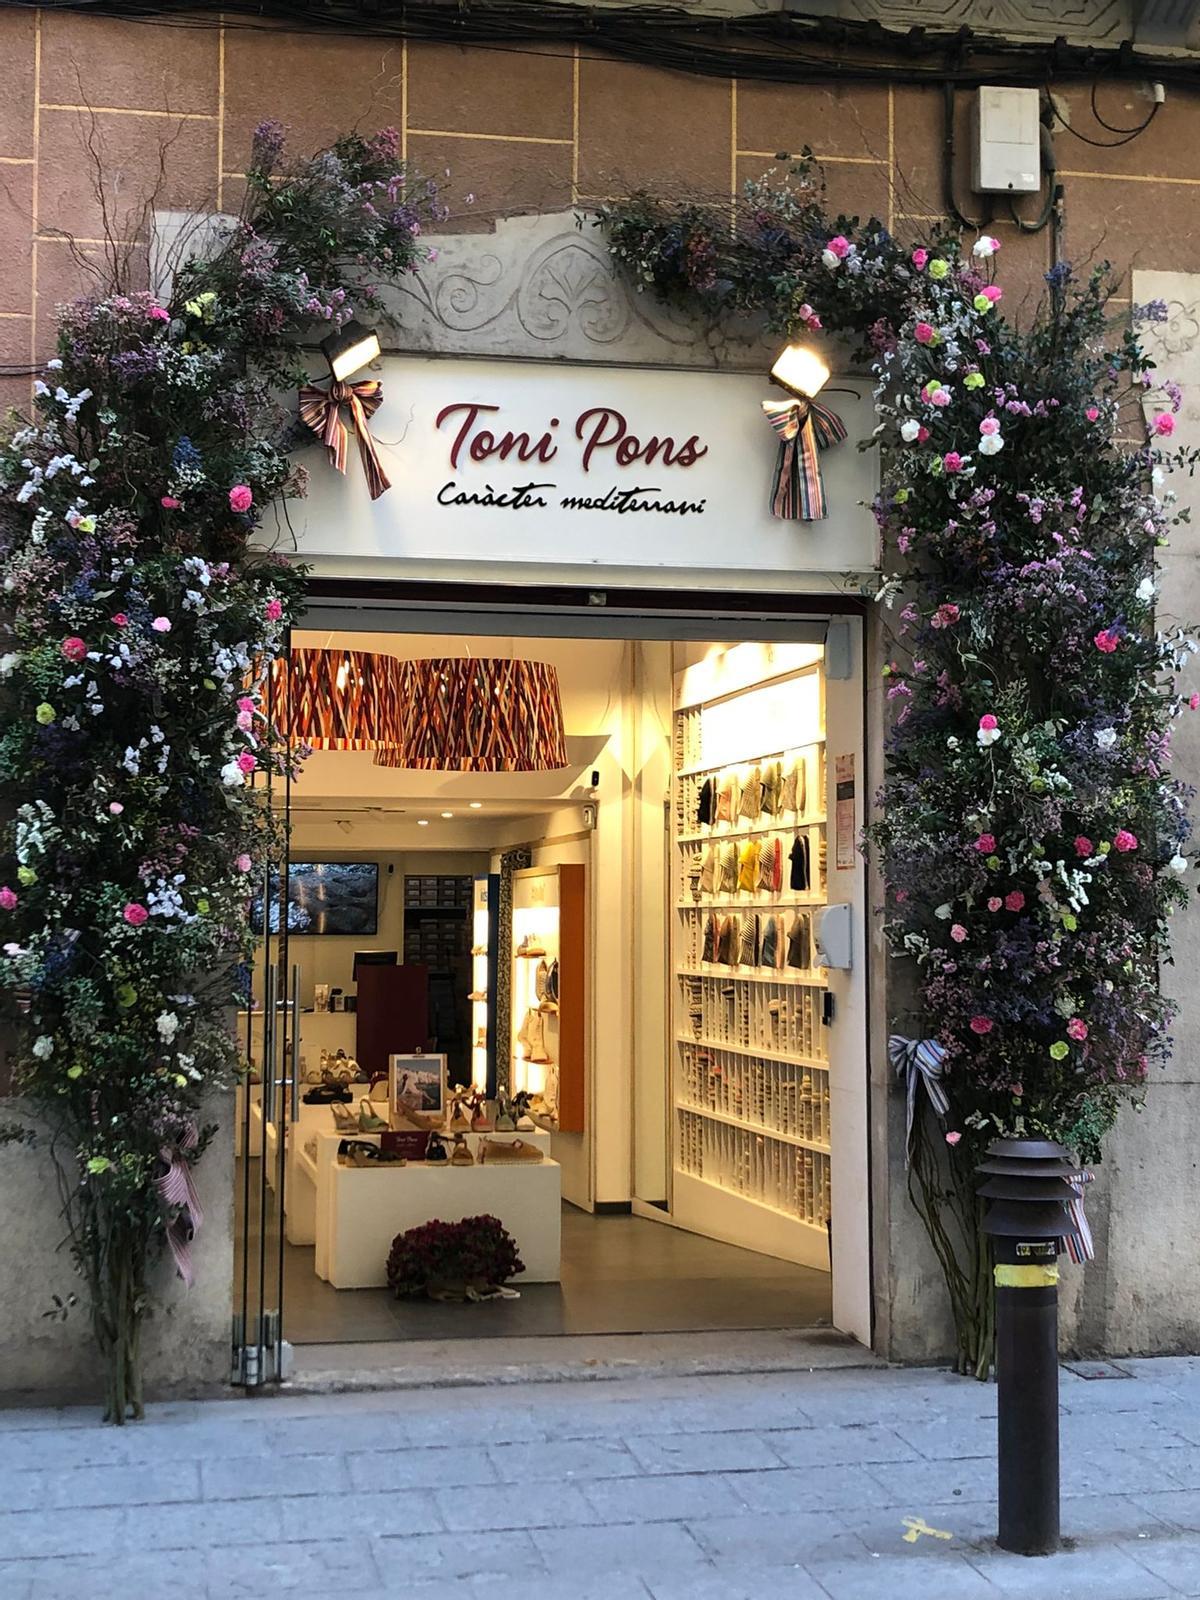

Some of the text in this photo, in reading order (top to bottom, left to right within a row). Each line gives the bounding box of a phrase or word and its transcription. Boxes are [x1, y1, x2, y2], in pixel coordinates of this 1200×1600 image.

[435, 403, 709, 473] Toni Pons
[437, 481, 707, 516] Caràcter mediterrani
